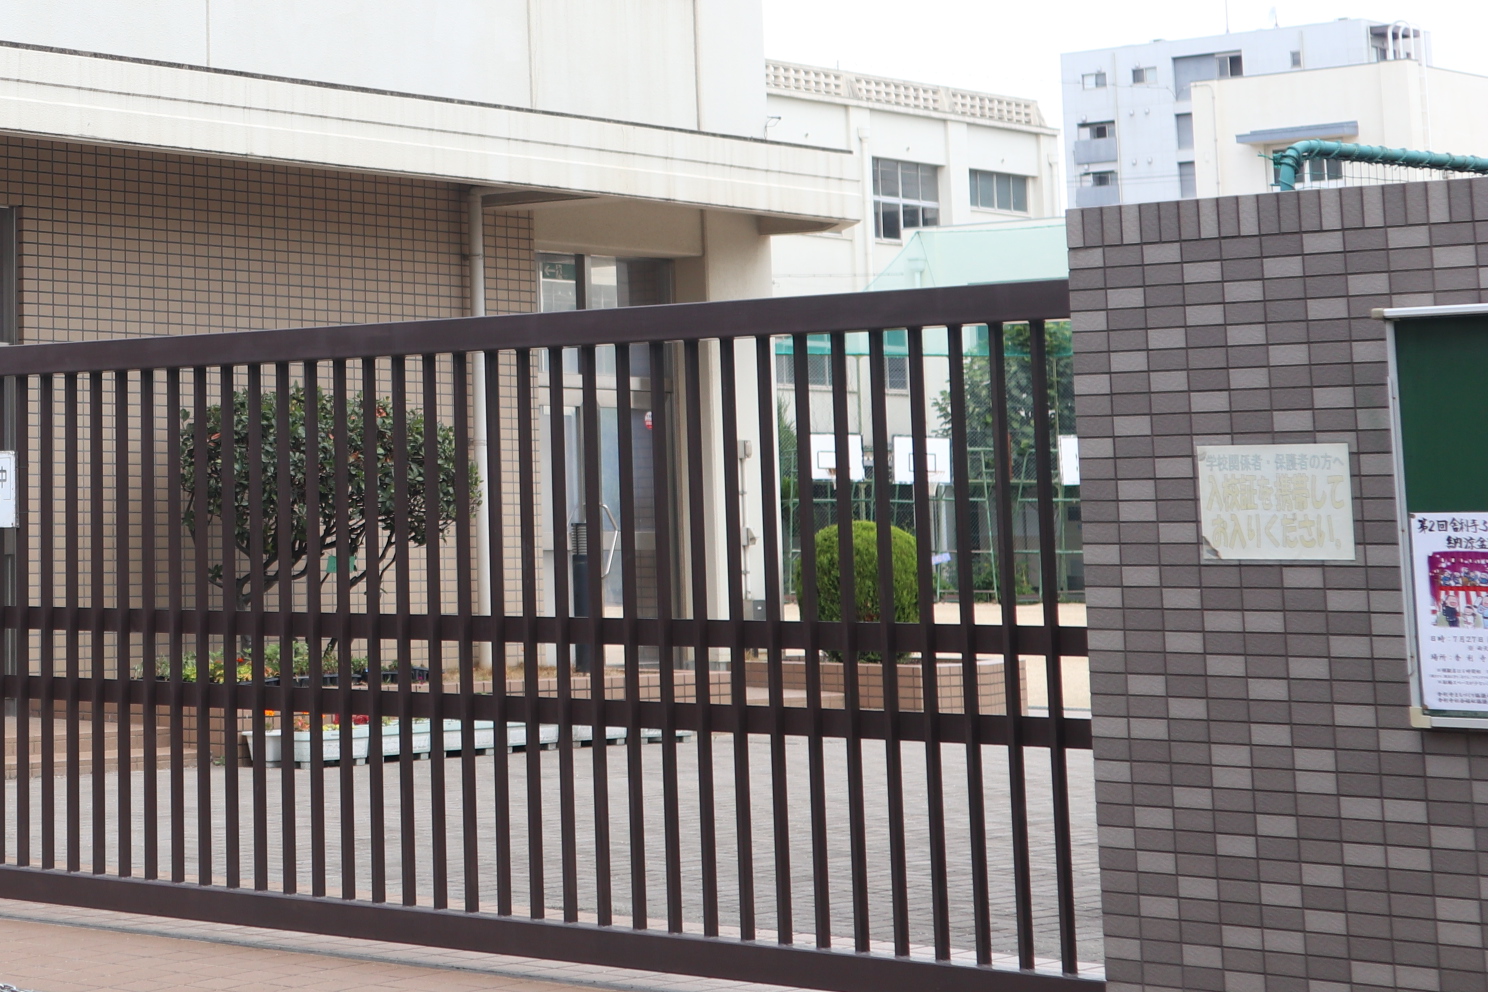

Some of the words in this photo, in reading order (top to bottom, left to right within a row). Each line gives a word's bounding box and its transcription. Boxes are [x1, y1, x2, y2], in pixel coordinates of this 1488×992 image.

[1205, 453, 1344, 472] 学校関係者・保護者の方へ
[1206, 473, 1345, 512] 入校証を携帯して
